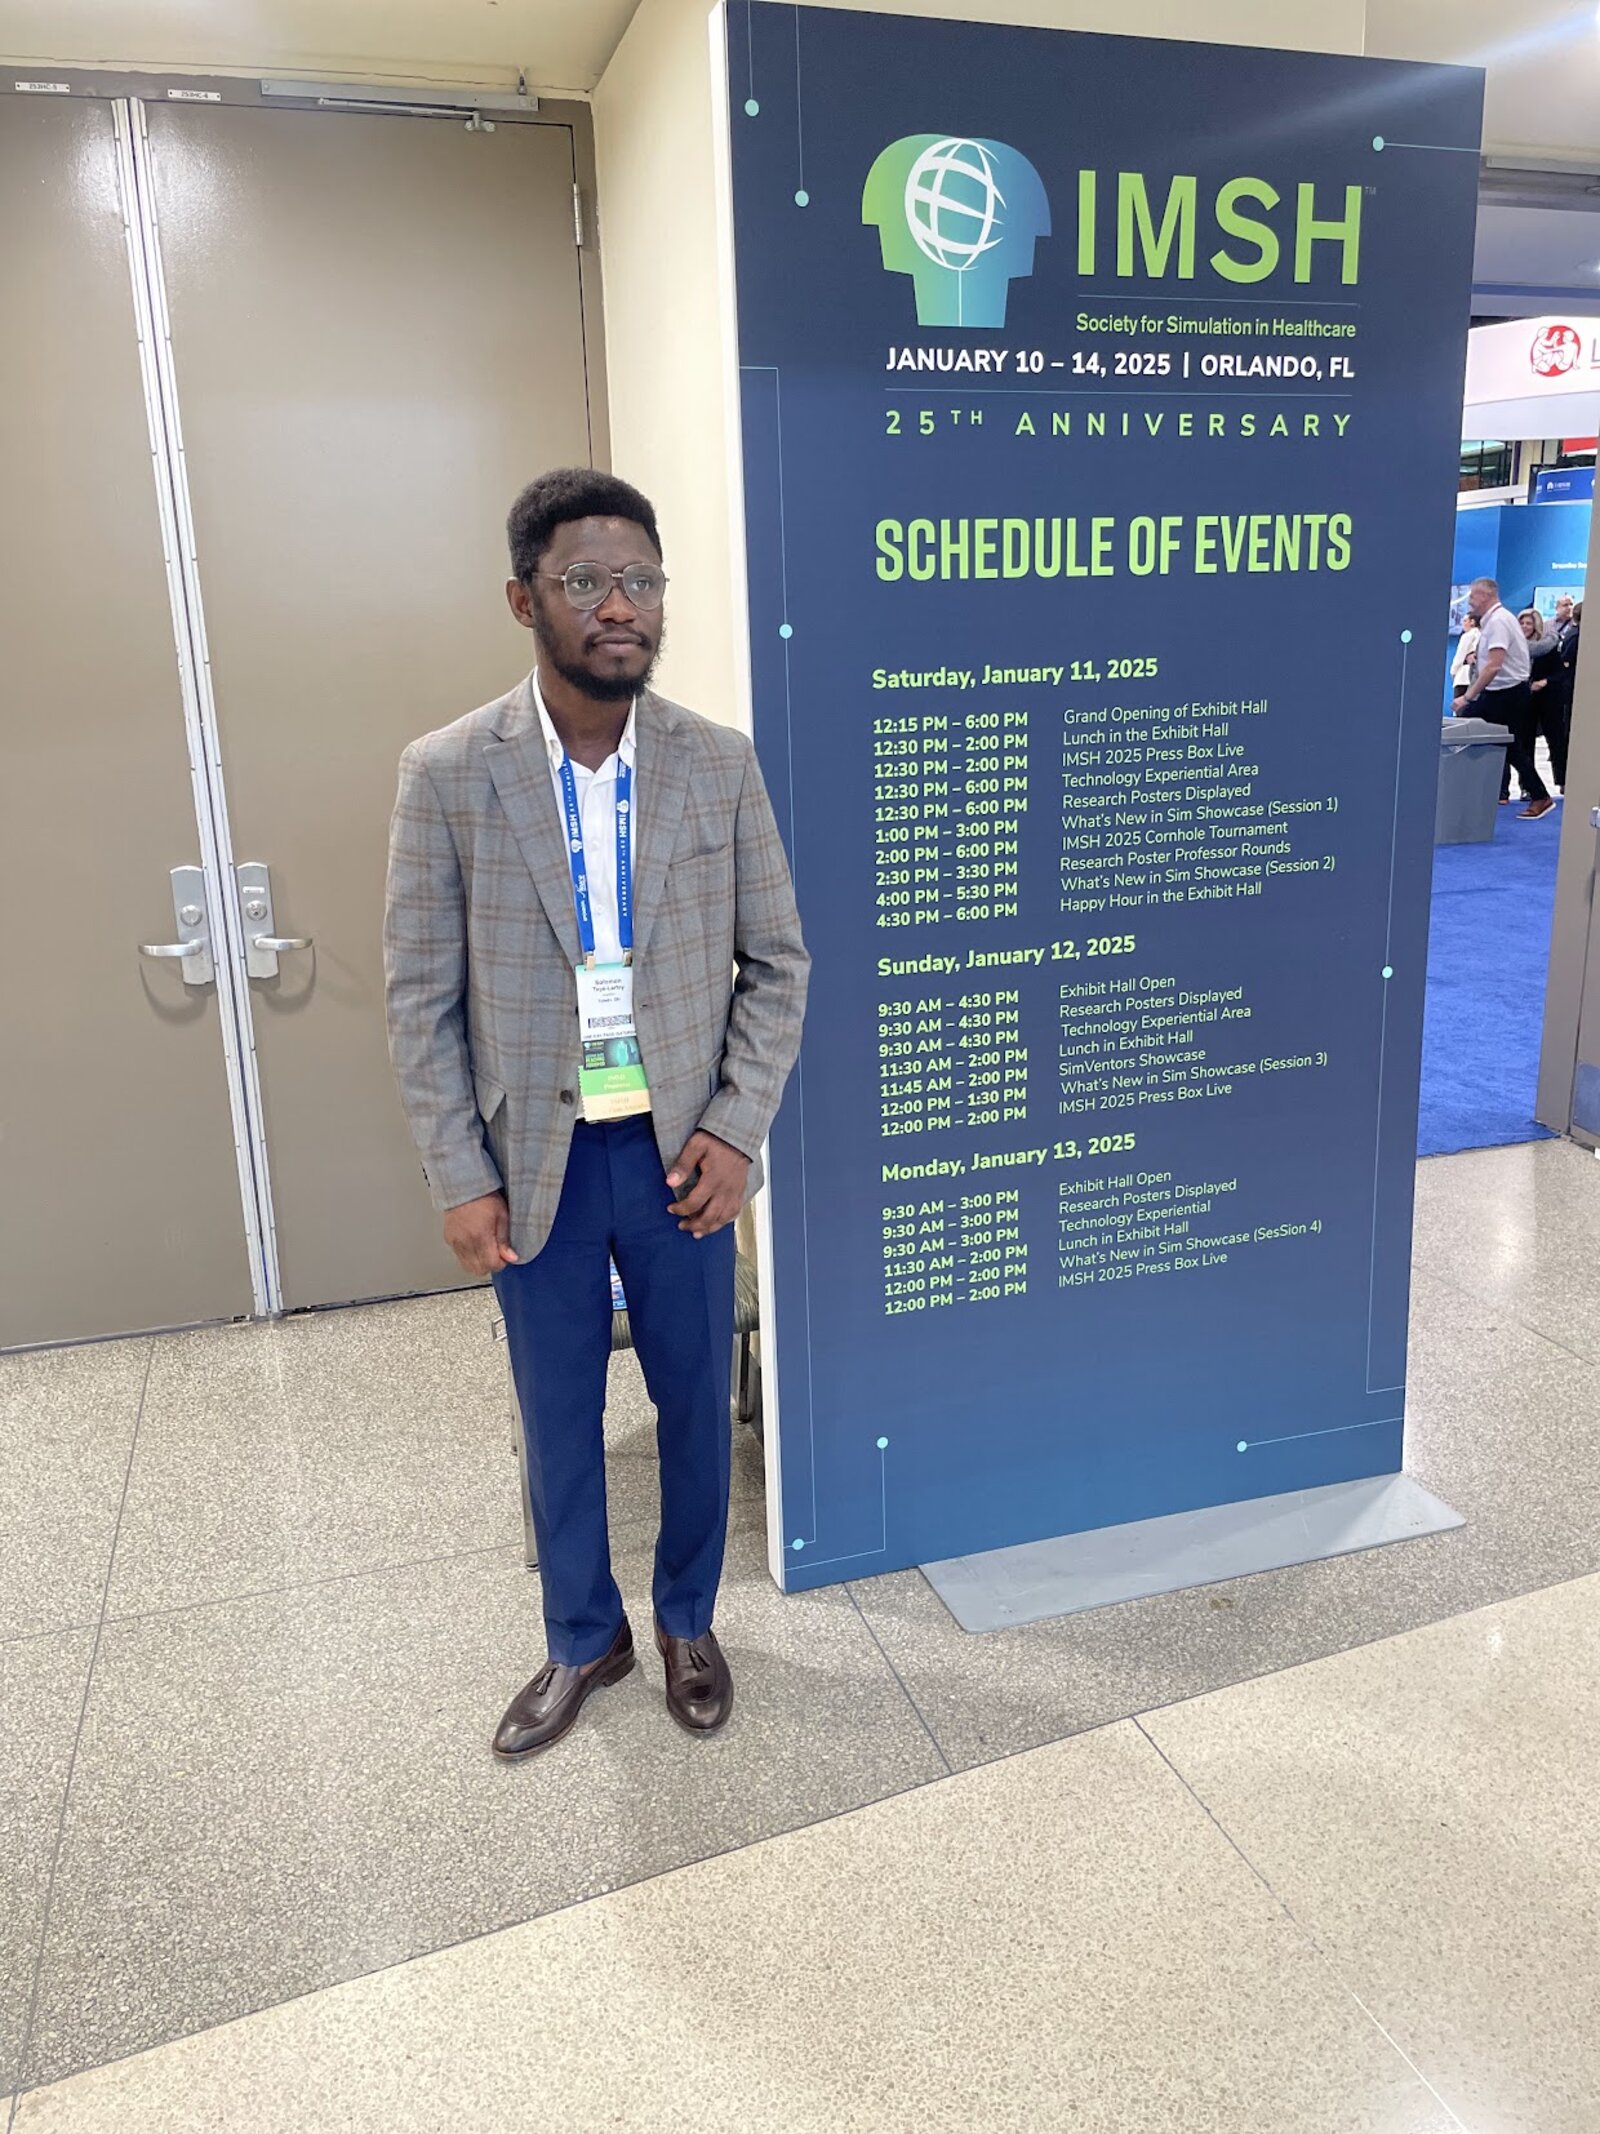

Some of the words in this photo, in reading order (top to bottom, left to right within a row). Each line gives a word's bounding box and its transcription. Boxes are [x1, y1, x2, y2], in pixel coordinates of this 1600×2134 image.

[1078, 170, 1362, 284] IMSH
[1076, 312, 1138, 336] Society
[1140, 315, 1164, 333] for
[1166, 315, 1252, 335] Simulation
[1255, 318, 1269, 335] in
[1272, 318, 1356, 337] Healthcare
[886, 347, 1009, 372] JANUARY
[1015, 350, 1044, 373] 10
[1072, 351, 1106, 378] 14,
[1114, 352, 1171, 375] 2025
[1201, 354, 1322, 381] ORLANDO,
[1329, 356, 1355, 378] FL
[1014, 411, 1352, 437] ANNIVERSARY
[875, 517, 1114, 581] SCHEDULE
[1128, 515, 1183, 575] OF
[1194, 513, 1352, 573] EVENTS
[872, 666, 976, 689] Saturday,
[981, 664, 1064, 685] January
[1070, 660, 1101, 682] 11,
[1107, 657, 1158, 679] 2025
[873, 717, 918, 734] 12:15
[923, 715, 947, 731] PM
[965, 713, 999, 729] 6:00
[1003, 711, 1028, 727] PM
[1064, 707, 1107, 724] Grand
[1111, 705, 1170, 724] Opening
[1173, 703, 1188, 718] of
[1191, 701, 1238, 717] Exhibit
[1241, 699, 1267, 714] Hall
[1063, 729, 1105, 745] Lunch
[1109, 728, 1122, 742] in
[1125, 727, 1148, 742] the
[1152, 724, 1199, 740] Exhibit
[1202, 722, 1229, 737] Hall
[1062, 750, 1100, 767] IMSH
[1105, 747, 1142, 764] 2025
[1146, 747, 1183, 761] Press
[1187, 744, 1213, 759] Box
[1217, 742, 1244, 757] Live
[1061, 770, 1141, 787] Technology
[1145, 763, 1223, 784] Experiential
[1226, 763, 1258, 777] Area
[1063, 791, 1127, 809] Research
[1131, 789, 1182, 804] Posters
[1185, 782, 1251, 802] Displayed
[1115, 811, 1147, 825] New
[1150, 809, 1163, 823] in
[1167, 807, 1192, 822] Sim
[1196, 805, 1264, 820] Showcase
[1268, 798, 1322, 817] (Session
[1326, 796, 1338, 812] 1)
[618, 814, 627, 838] IMSH
[1062, 834, 1100, 850] IMSH
[1105, 830, 1141, 847] 2025
[1145, 826, 1205, 844] Cornhole
[1208, 821, 1288, 839] Tournament
[1060, 853, 1123, 871] Research
[1127, 851, 1172, 865] Poster
[1175, 846, 1238, 862] Professor
[1241, 840, 1291, 856] Rounds
[1114, 872, 1146, 887] New
[1149, 870, 1161, 884] in
[1165, 868, 1190, 883] Sim
[1194, 865, 1262, 880] Showcase
[1265, 858, 1319, 876] (Session
[1322, 855, 1335, 871] 2)
[1060, 897, 1106, 913] Happy
[1109, 893, 1144, 907] Hour
[1146, 890, 1159, 904] in
[1162, 888, 1184, 902] the
[1188, 884, 1233, 901] Exhibit
[1236, 881, 1262, 896] Hall
[877, 954, 960, 976] Sunday,
[965, 947, 1045, 968] January
[1051, 940, 1080, 960] 12,
[1086, 934, 1135, 956] 2025
[1059, 999, 1121, 1018] Research
[1125, 996, 1175, 1011] Posters
[1178, 986, 1242, 1006] Displayed
[1060, 981, 1106, 999] Exhibit
[1109, 977, 1136, 993] Hall
[1139, 976, 1175, 992] Open
[878, 1000, 912, 1017] 9:30
[915, 997, 941, 1013] AM
[958, 992, 991, 1008] 4:30
[995, 990, 1018, 1005] PM
[1060, 1018, 1138, 1037] Technology
[1141, 1007, 1217, 1029] Experiential
[1220, 1006, 1251, 1020] Area
[1059, 1040, 1099, 1057] Lunch
[1103, 1039, 1115, 1052] in
[1119, 1033, 1164, 1050] Exhibit
[1167, 1029, 1193, 1044] Hall
[1058, 1058, 1135, 1076] SimVentors
[1138, 1049, 1206, 1067] Showcase
[1112, 1075, 1143, 1088] New
[1146, 1071, 1158, 1084] in
[1162, 1069, 1186, 1083] Sim
[1190, 1062, 1256, 1079] Showcase
[1259, 1055, 1312, 1074] (Session
[1315, 1051, 1327, 1066] 3)
[1059, 1097, 1095, 1114] IMSH
[1099, 1092, 1135, 1109] 2025
[1138, 1091, 1174, 1104] Press
[1177, 1086, 1203, 1100] Box
[1206, 1082, 1232, 1096] Live
[882, 1158, 965, 1182] Monday,
[970, 1148, 1048, 1170] January
[1053, 1140, 1082, 1159] 13,
[1088, 1132, 1135, 1155] 2025
[1059, 1178, 1104, 1196] Exhibit
[1107, 1173, 1133, 1189] Hall
[1136, 1171, 1171, 1186] Open
[1059, 1194, 1119, 1214] Research
[1123, 1190, 1171, 1205] Posters
[1174, 1177, 1236, 1198] Displayed
[1058, 1213, 1133, 1232] Technology
[1136, 1199, 1210, 1222] Experiential
[1058, 1234, 1098, 1251] Lunch
[1101, 1232, 1113, 1245] in
[1117, 1225, 1161, 1243] Exhibit
[1164, 1220, 1189, 1235] Hall
[1109, 1248, 1140, 1261] New
[1143, 1244, 1155, 1257] in
[1158, 1240, 1182, 1254] Sim
[1185, 1232, 1250, 1250] Showcase
[1309, 1219, 1322, 1233] 4)
[1058, 1270, 1094, 1287] IMSH
[1098, 1264, 1132, 1282] 2025
[1136, 1261, 1171, 1276] Press
[1174, 1257, 1199, 1270] Box
[1202, 1252, 1228, 1266] Live
[884, 1296, 925, 1315] 12:00
[929, 1292, 953, 1308] PM
[968, 1285, 1000, 1301] 2:00
[1004, 1280, 1026, 1296] PM
